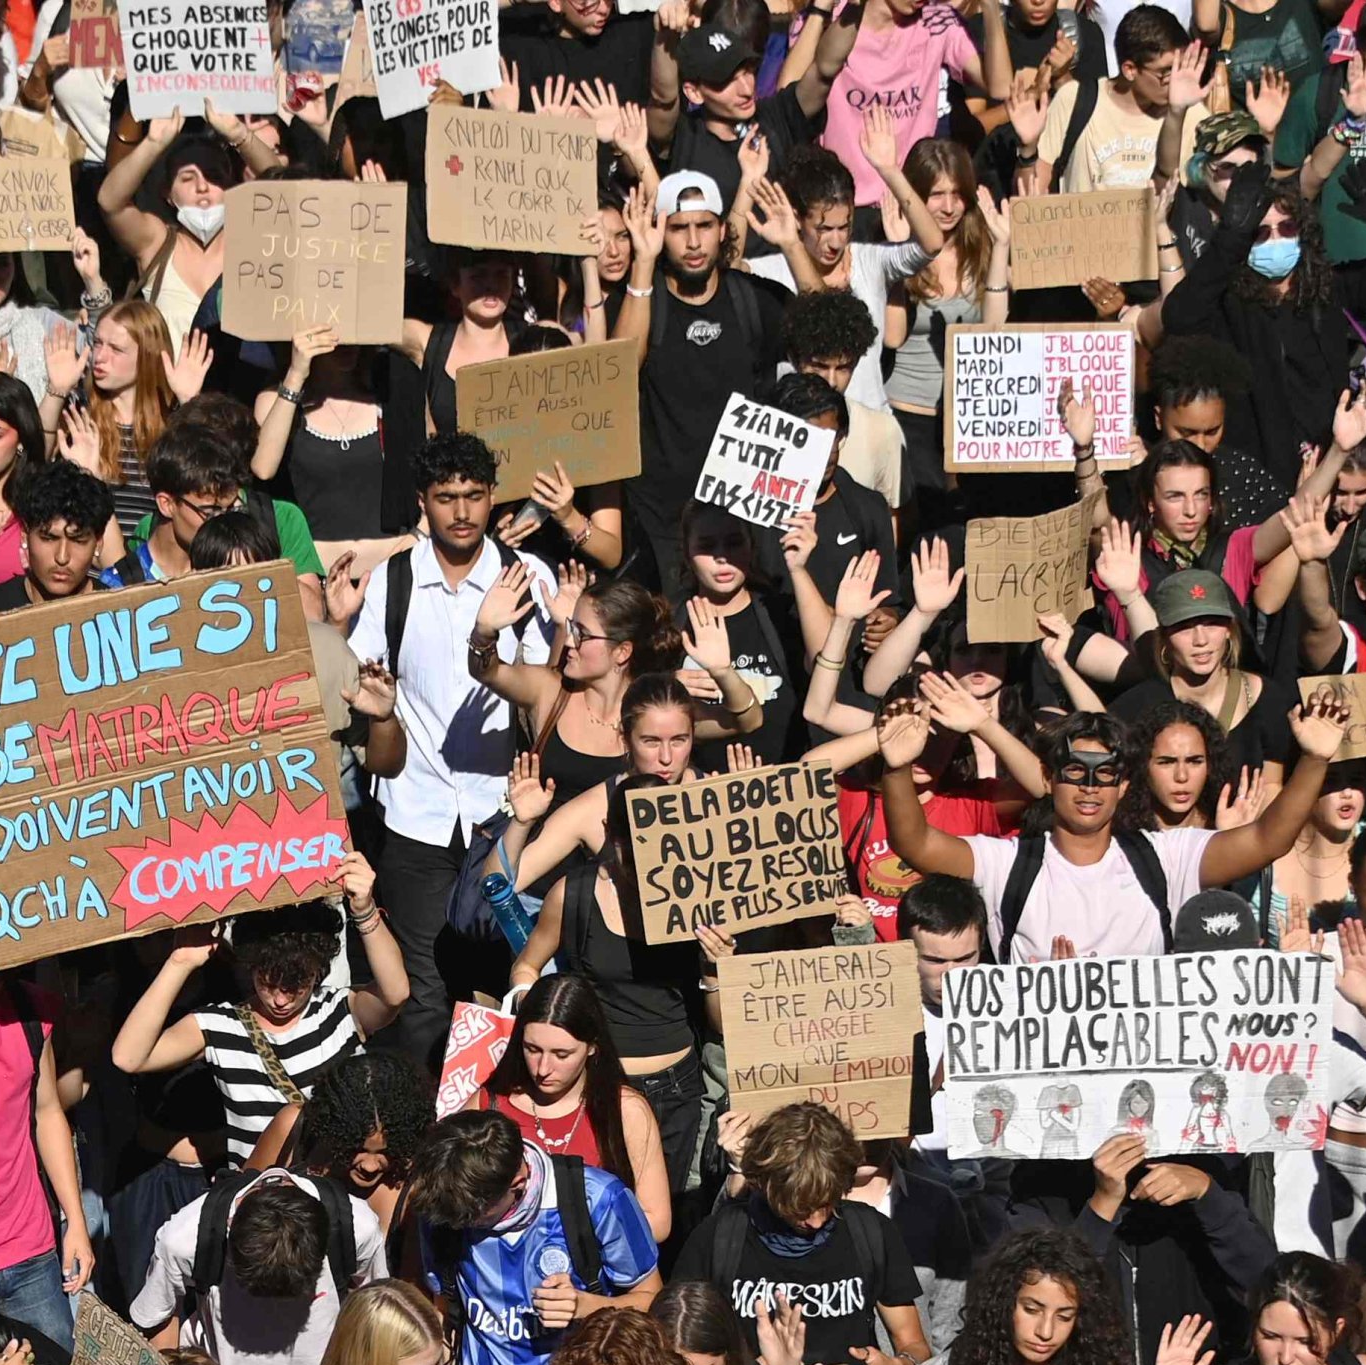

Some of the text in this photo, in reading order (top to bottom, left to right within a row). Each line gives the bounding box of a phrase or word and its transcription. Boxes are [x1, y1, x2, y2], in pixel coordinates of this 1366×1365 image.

[129, 5, 269, 28] MES ABSENCES
[370, 2, 393, 26] DES
[373, 29, 386, 50] DE
[447, 3, 491, 30] POUR
[132, 27, 248, 50] CHOQUENT
[376, 26, 493, 76] LES VICTIMES DE
[134, 53, 257, 74] QUE VOTRE
[417, 63, 442, 87] VSS
[846, 86, 922, 112] QATAR
[521, 126, 541, 154] DU
[535, 167, 573, 194] QUE
[31, 194, 67, 213] NOUS
[252, 193, 392, 233] PAS DE
[473, 187, 587, 216] LE DE
[1012, 200, 1073, 225] Quand
[482, 214, 557, 243] MARINE
[262, 233, 393, 263] JUSTICE
[238, 261, 345, 292] PAS DE
[272, 295, 341, 324] PAIX
[956, 335, 1022, 356] LUNDI
[1044, 334, 1128, 354] J'BLOQUE
[478, 353, 621, 402] J'AIMERAIS
[956, 357, 1003, 377] MARDI
[1044, 355, 1126, 374] J'BLOQUE
[956, 373, 1042, 397] MERCREDI
[537, 397, 583, 414] AUSSI
[957, 397, 1019, 417] JEUDI
[571, 410, 615, 432] QUE
[730, 402, 809, 450] SIAMO
[957, 418, 1042, 437] VENDREDI
[717, 433, 787, 473] TUTTI
[957, 439, 1064, 461] POUR NOTRE
[751, 470, 810, 504] ANTI
[1038, 537, 1069, 557] EN
[53, 594, 183, 695] UNE
[195, 577, 279, 655] SI
[34, 671, 311, 787] MATRAQUE
[183, 740, 325, 814] AVOIR
[632, 761, 837, 829] DE LA BOETIE
[726, 803, 841, 856] BLOCUS
[128, 832, 348, 906] COMPENSER
[645, 858, 760, 907] SOYEZ
[67, 854, 110, 922] À
[666, 887, 784, 936] A PLUS
[749, 949, 892, 990] J'AIMERAIS
[944, 953, 1334, 1019] VOS POUBELLES SONT
[743, 981, 895, 1022] ÊTRE AUSSI
[803, 1041, 850, 1067] QUE
[734, 1055, 913, 1091] MON EMPLOI
[809, 1086, 839, 1105] DU
